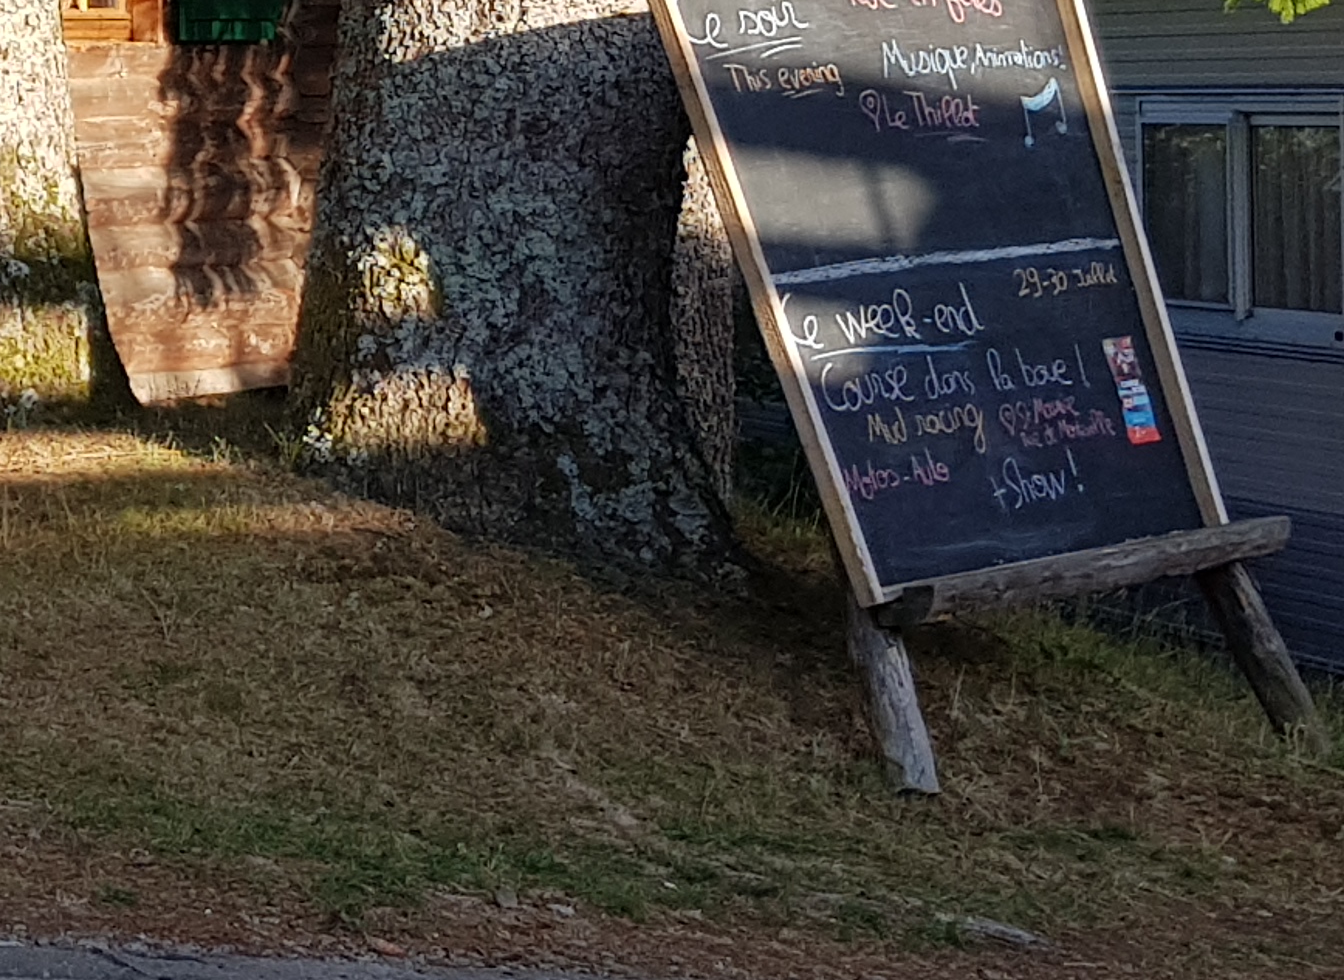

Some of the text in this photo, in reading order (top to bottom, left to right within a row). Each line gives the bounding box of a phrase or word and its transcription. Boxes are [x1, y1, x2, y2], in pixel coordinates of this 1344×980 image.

[723, 61, 845, 97] This evening
[820, 361, 915, 412] Course
[867, 402, 986, 454] Mud racing
